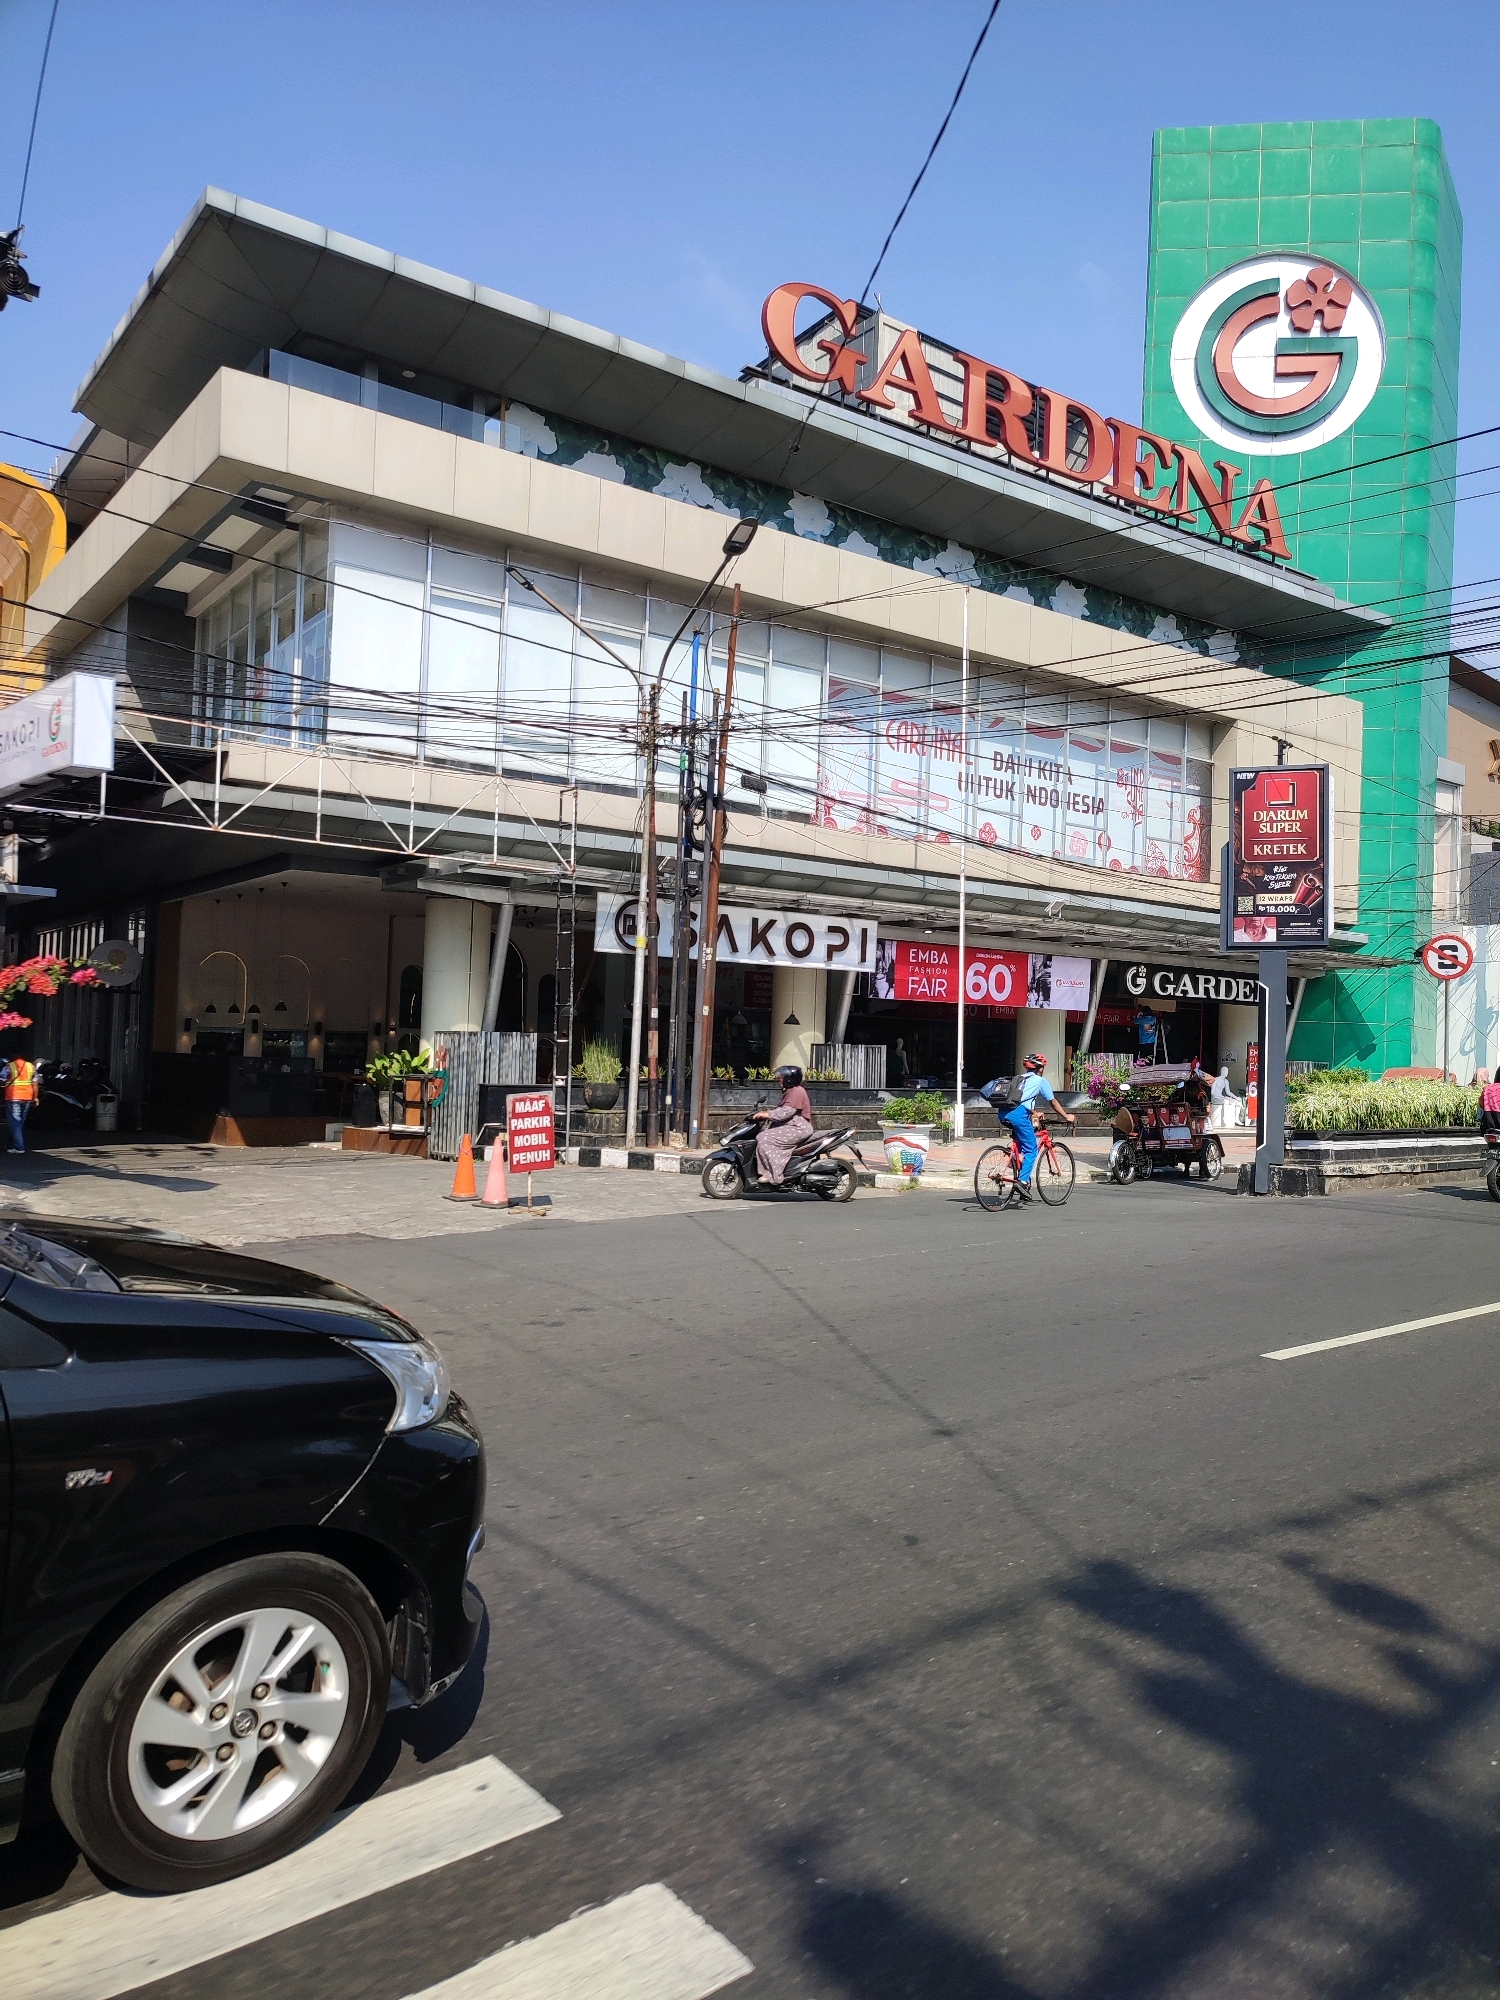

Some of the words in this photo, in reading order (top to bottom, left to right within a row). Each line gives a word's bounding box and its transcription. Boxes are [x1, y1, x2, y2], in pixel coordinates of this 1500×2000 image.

[761, 281, 1294, 561] GARDENA
[1236, 772, 1255, 780] NEW
[1253, 809, 1309, 823] DJARUM
[1258, 821, 1302, 834] SUPER
[1253, 843, 1308, 856] KRETEK
[909, 948, 949, 965] EMBA
[909, 966, 948, 976] FASHION
[908, 976, 948, 998] FAIR
[995, 1006, 1015, 1015] EMBA
[515, 1100, 545, 1113] MAAF
[511, 1115, 551, 1130] PARKIR
[514, 1133, 549, 1147] MOBIL
[512, 1149, 550, 1165] PENUH
